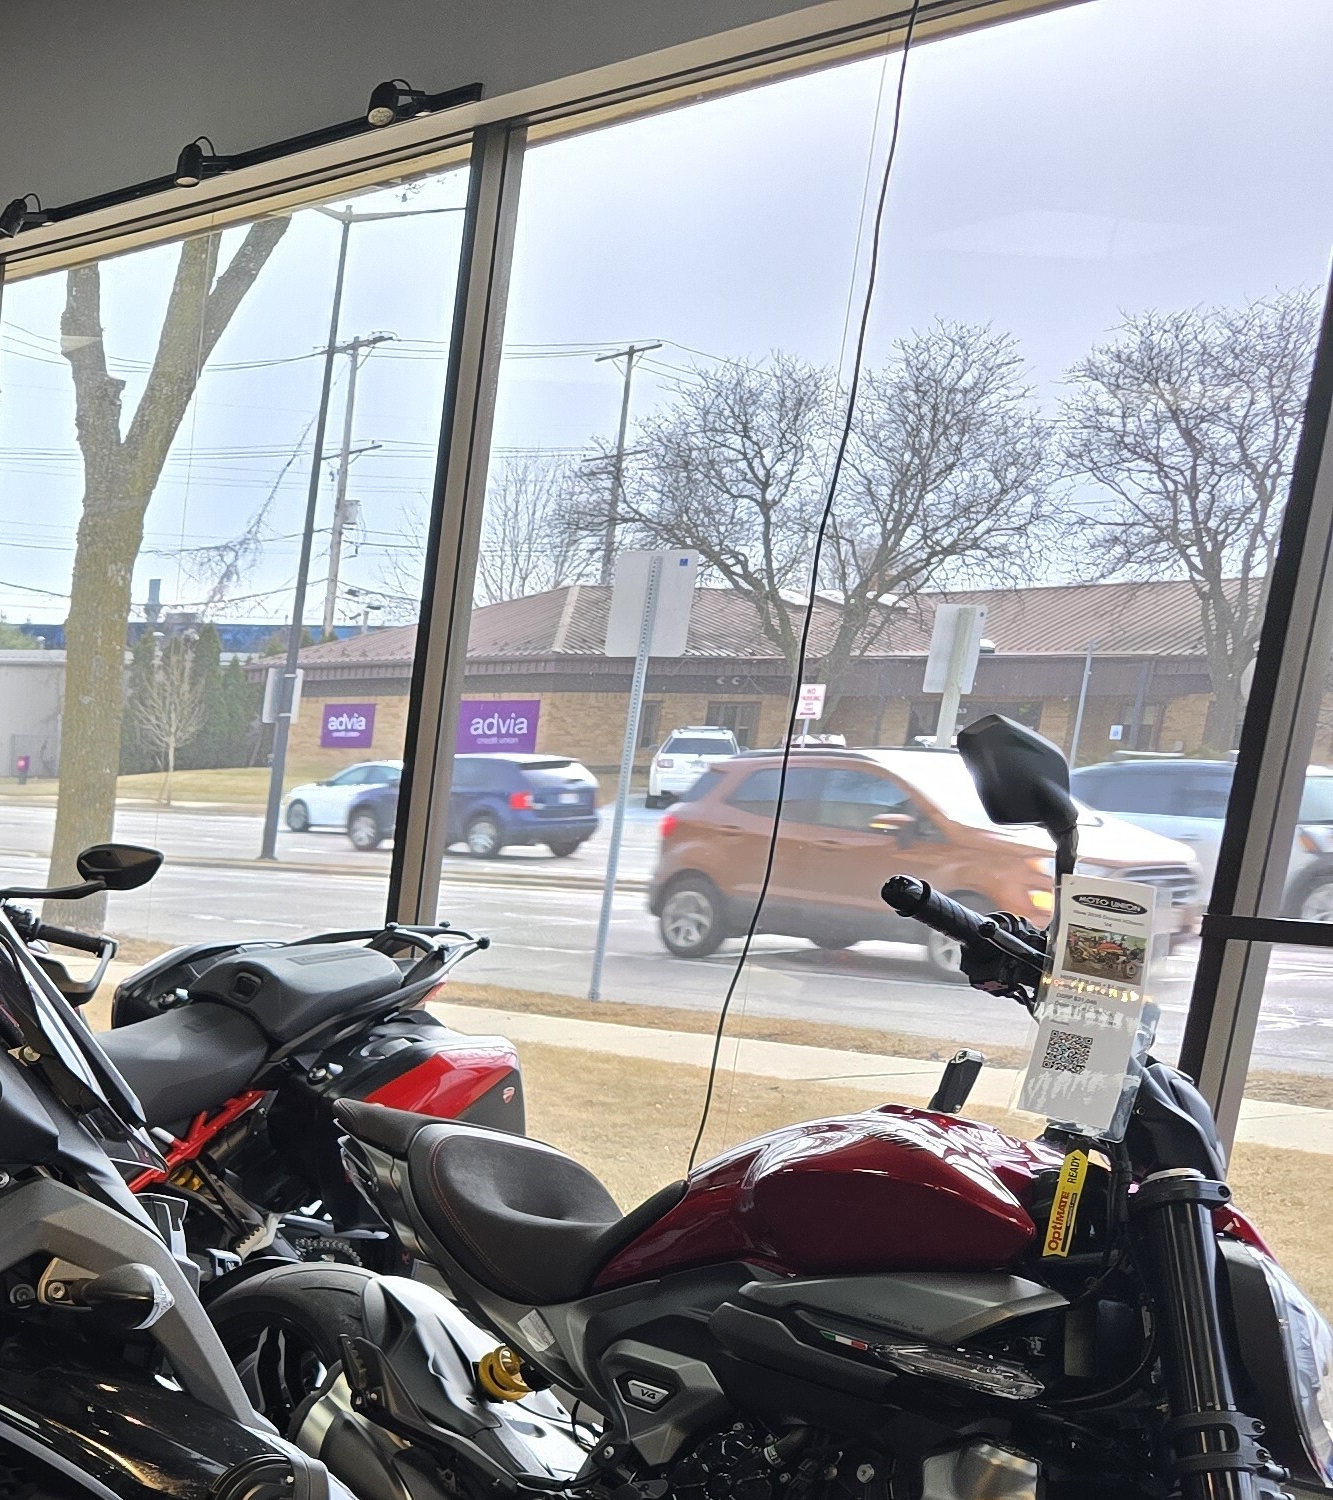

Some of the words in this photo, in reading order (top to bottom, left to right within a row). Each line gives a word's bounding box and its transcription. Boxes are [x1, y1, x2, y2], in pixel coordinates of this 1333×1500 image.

[328, 713, 366, 730] advia
[470, 713, 528, 735] advia
[1079, 896, 1109, 906] MOTO
[1111, 901, 1141, 911] UNION
[1067, 1156, 1081, 1184] READY
[641, 1389, 656, 1400] V4
